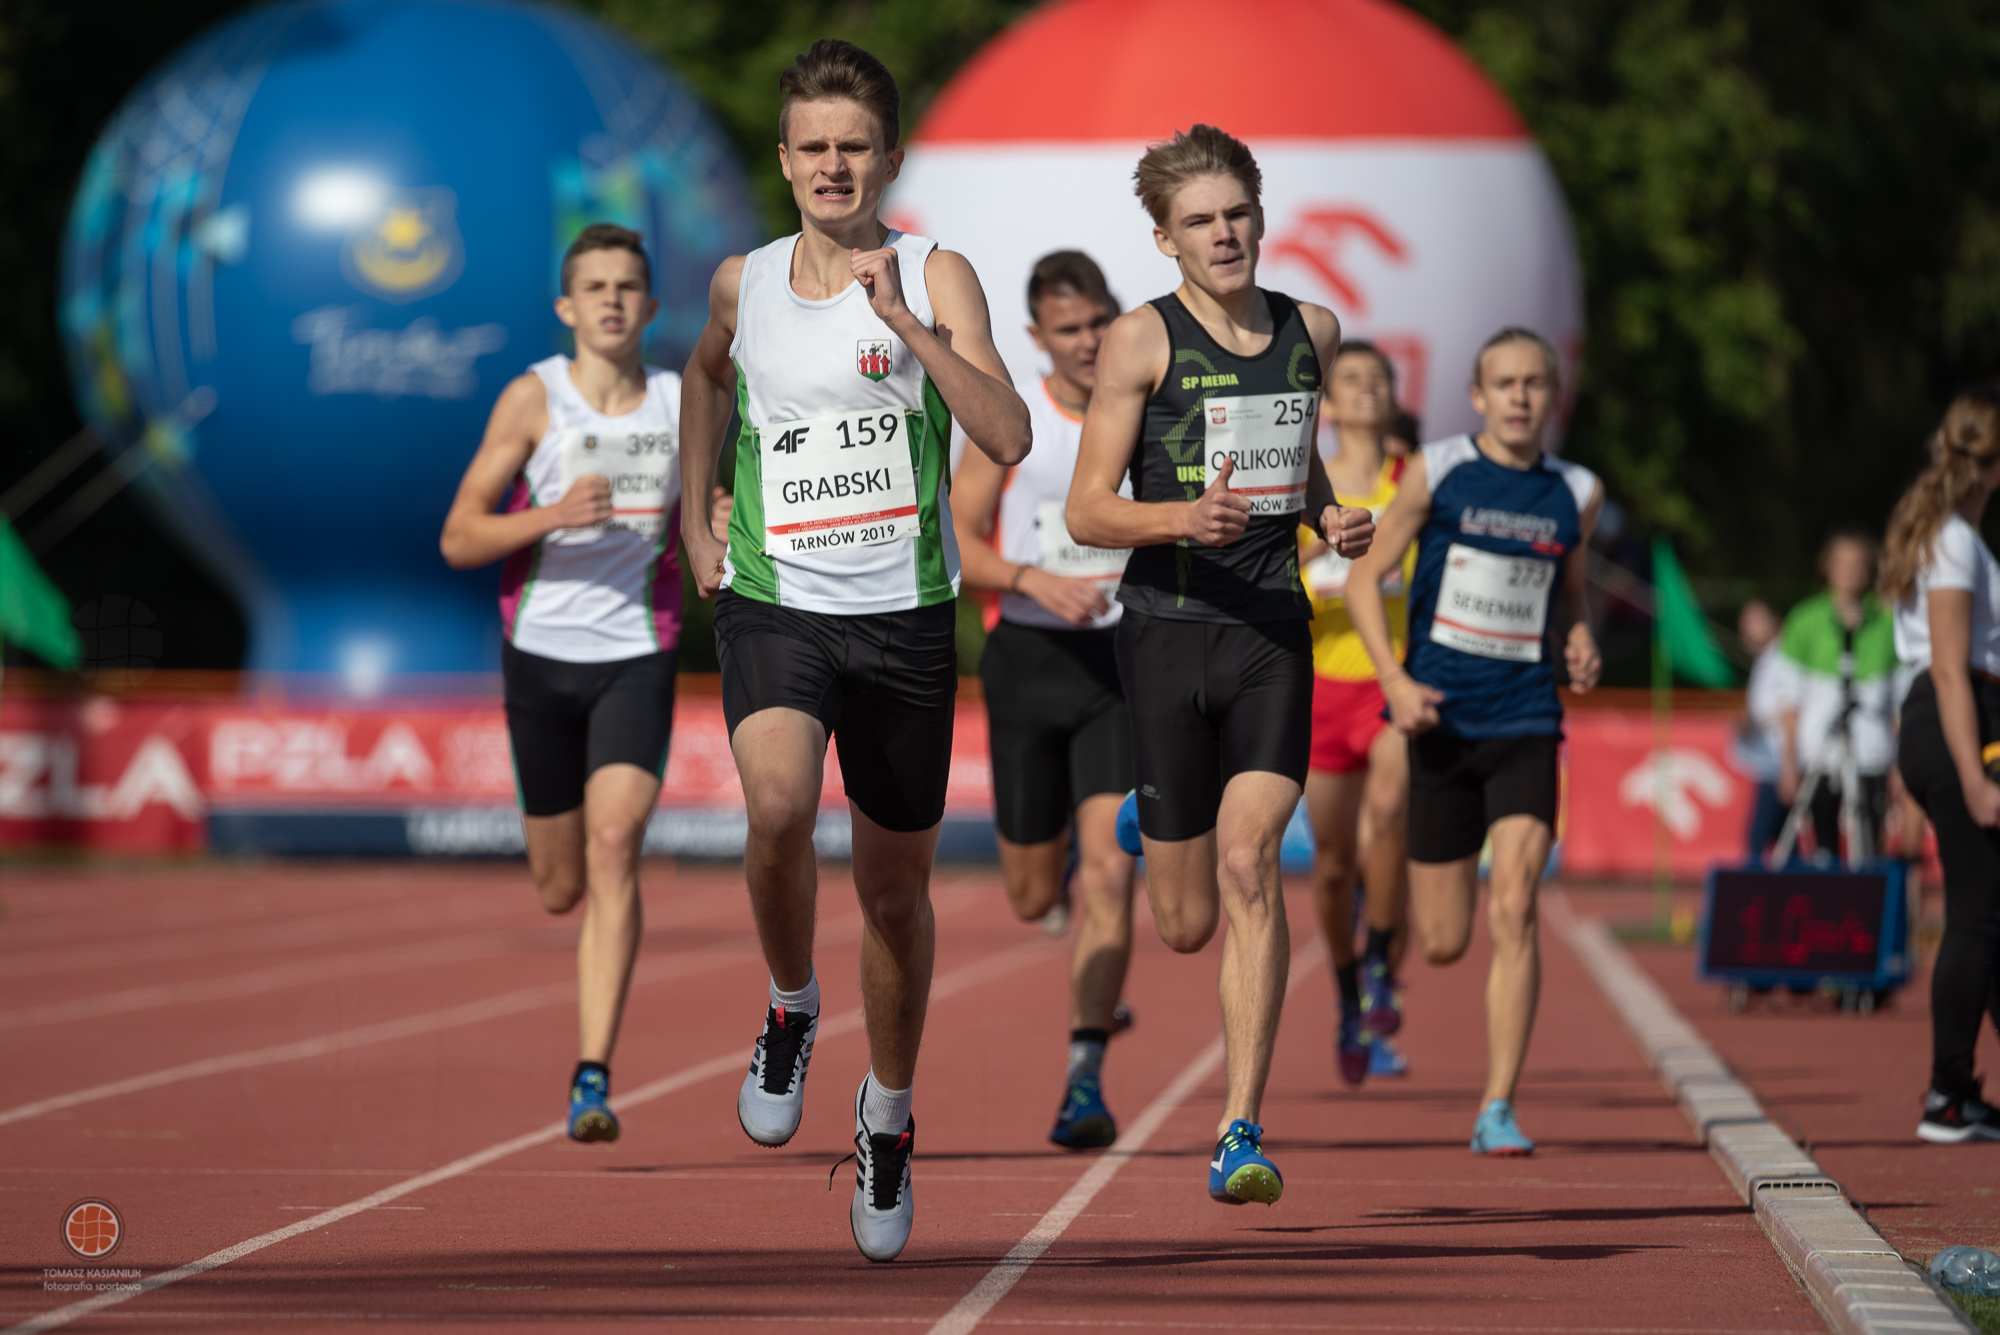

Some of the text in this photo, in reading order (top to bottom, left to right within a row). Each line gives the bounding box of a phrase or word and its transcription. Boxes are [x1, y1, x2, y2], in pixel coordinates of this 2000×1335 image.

[1181, 373, 1239, 390] SP MEDIA
[1273, 398, 1314, 426] 254
[626, 432, 673, 457] 398
[772, 426, 810, 454] 4F
[836, 413, 898, 450] 159
[782, 467, 892, 504] GRABSKI
[1176, 465, 1206, 483] UKS
[790, 524, 895, 551] TARNÓW 2019
[208, 717, 436, 793] PZLA
